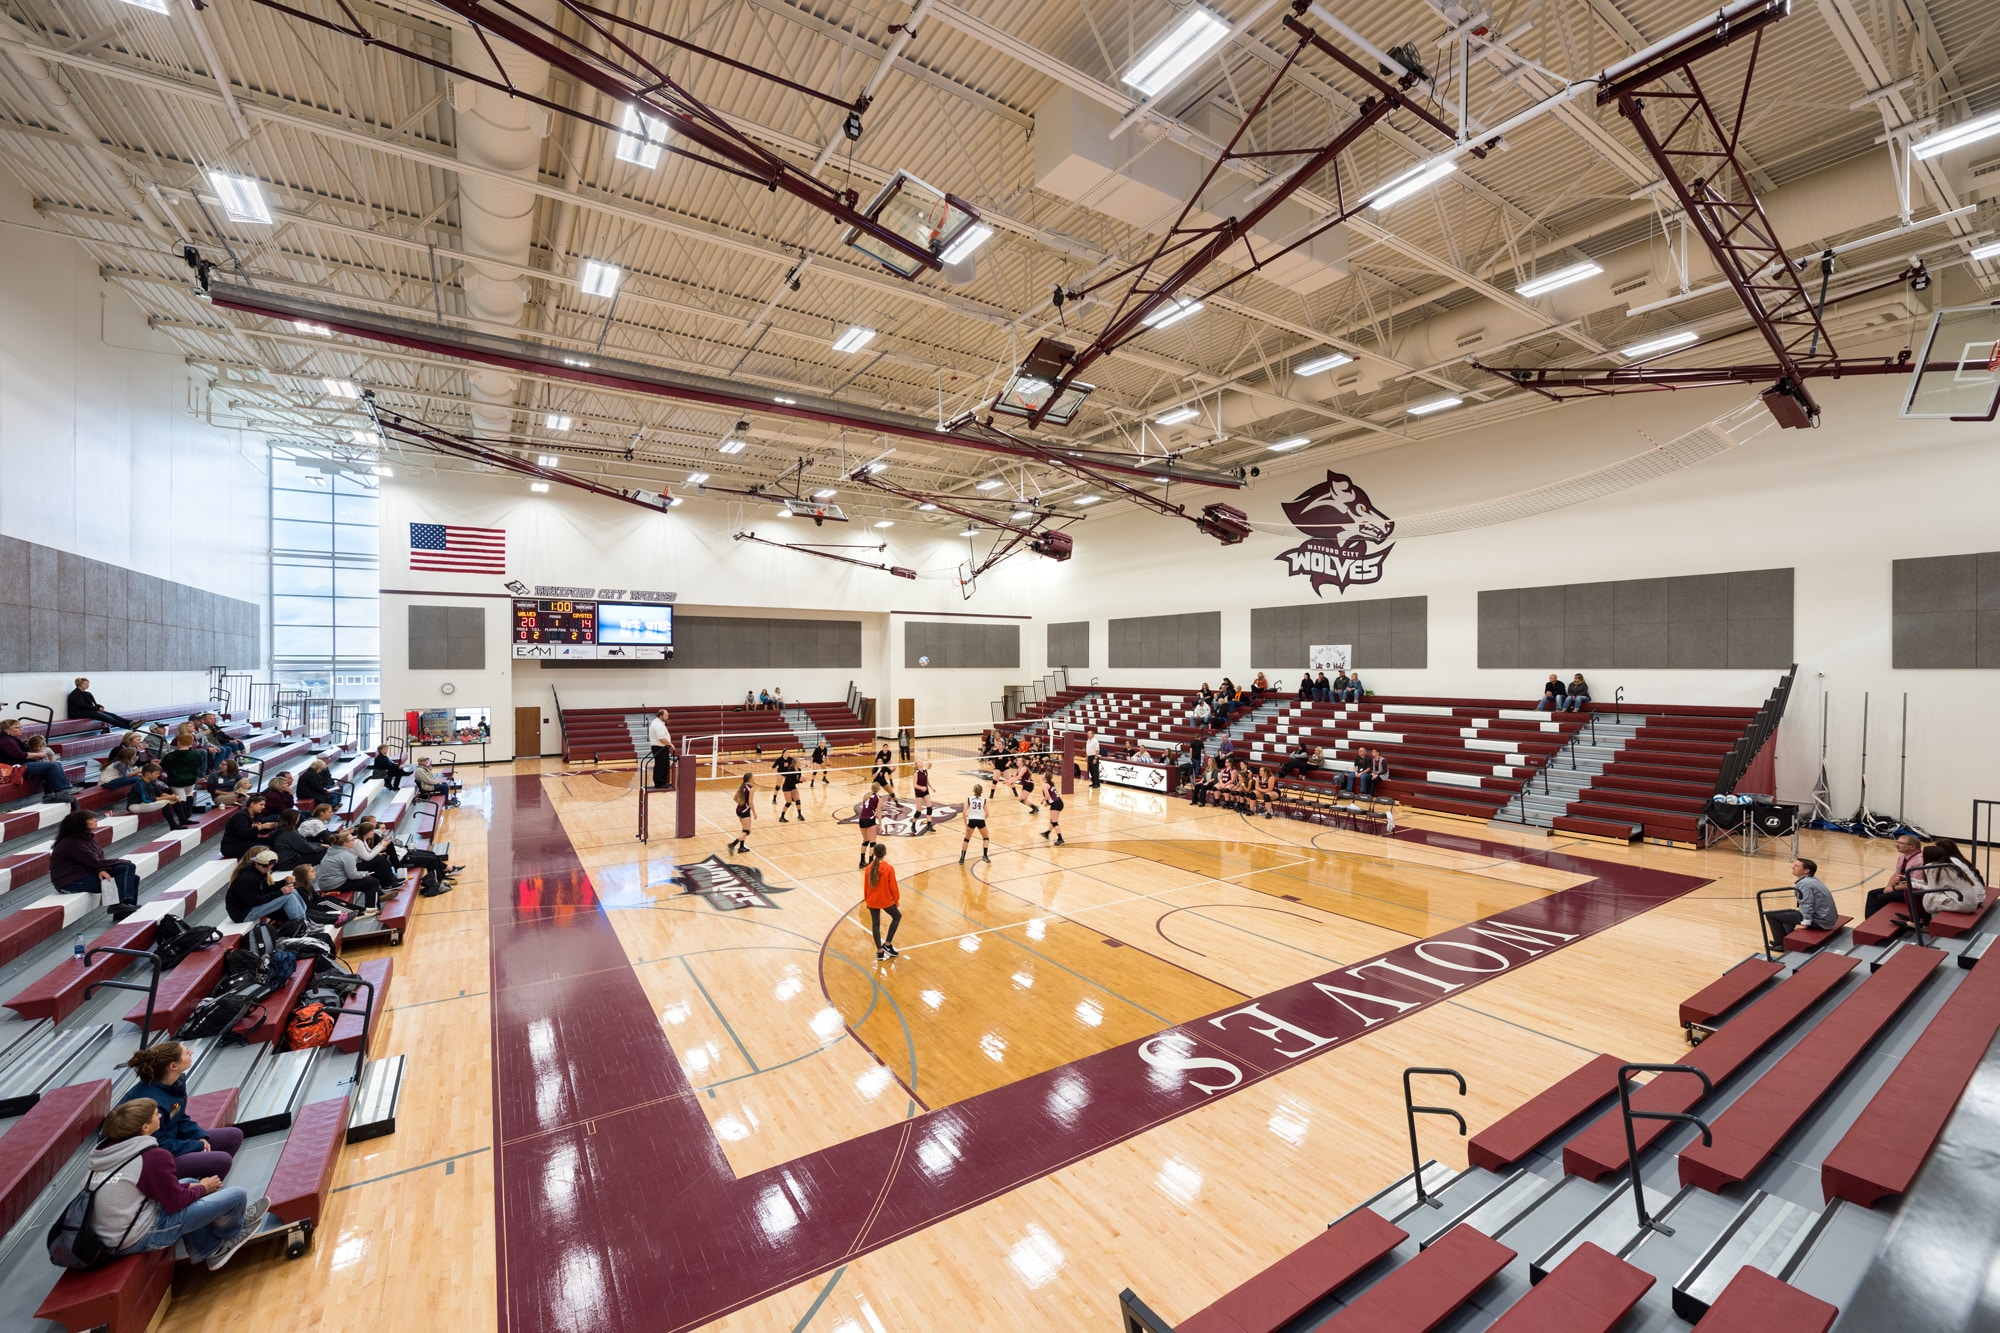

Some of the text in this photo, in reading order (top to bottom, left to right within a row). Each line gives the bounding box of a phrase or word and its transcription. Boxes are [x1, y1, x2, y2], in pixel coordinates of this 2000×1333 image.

[1342, 550, 1360, 558] CITY
[1286, 552, 1383, 583] WOLVES
[597, 588, 627, 600] CITY
[551, 601, 571, 612] 1:00
[521, 617, 536, 627] 20
[581, 619, 592, 628] 14
[520, 631, 527, 639] 0
[533, 631, 540, 640] 2
[571, 632, 578, 640] 2
[585, 632, 592, 640] 0
[972, 801, 982, 810] 34
[1138, 919, 1580, 1096] WOLVES
